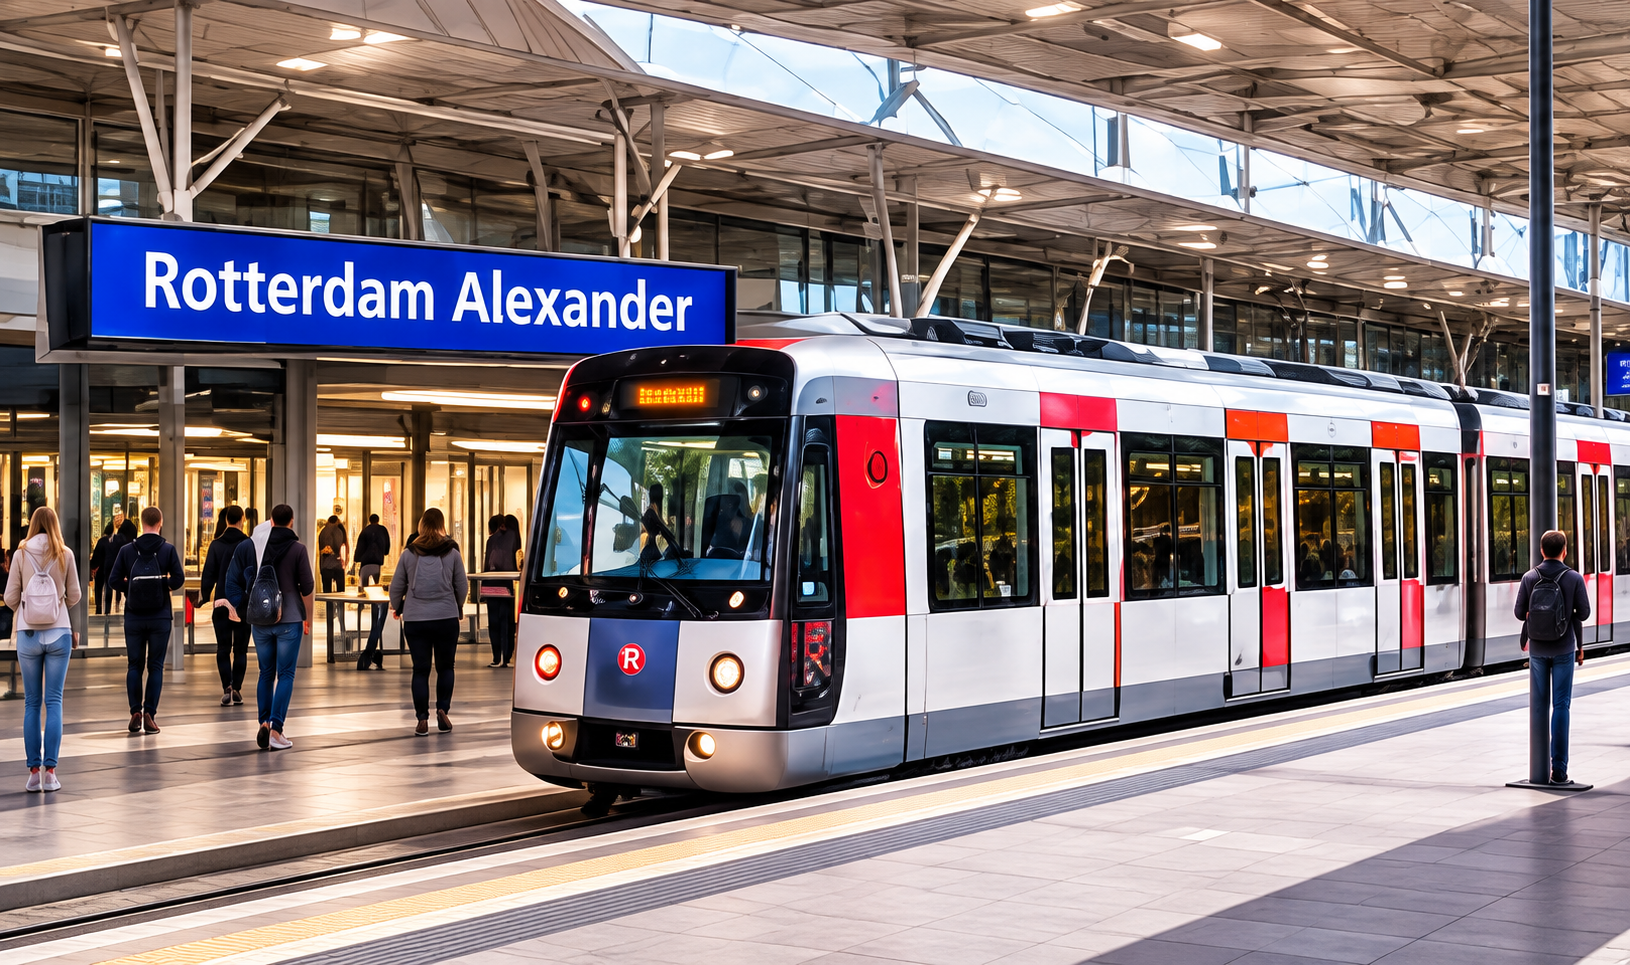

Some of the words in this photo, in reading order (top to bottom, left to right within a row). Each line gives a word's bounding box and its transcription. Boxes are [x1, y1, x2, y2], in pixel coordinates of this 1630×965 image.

[144, 251, 434, 321] Rotterdam
[452, 269, 693, 332] Alexander
[623, 648, 640, 670] R
